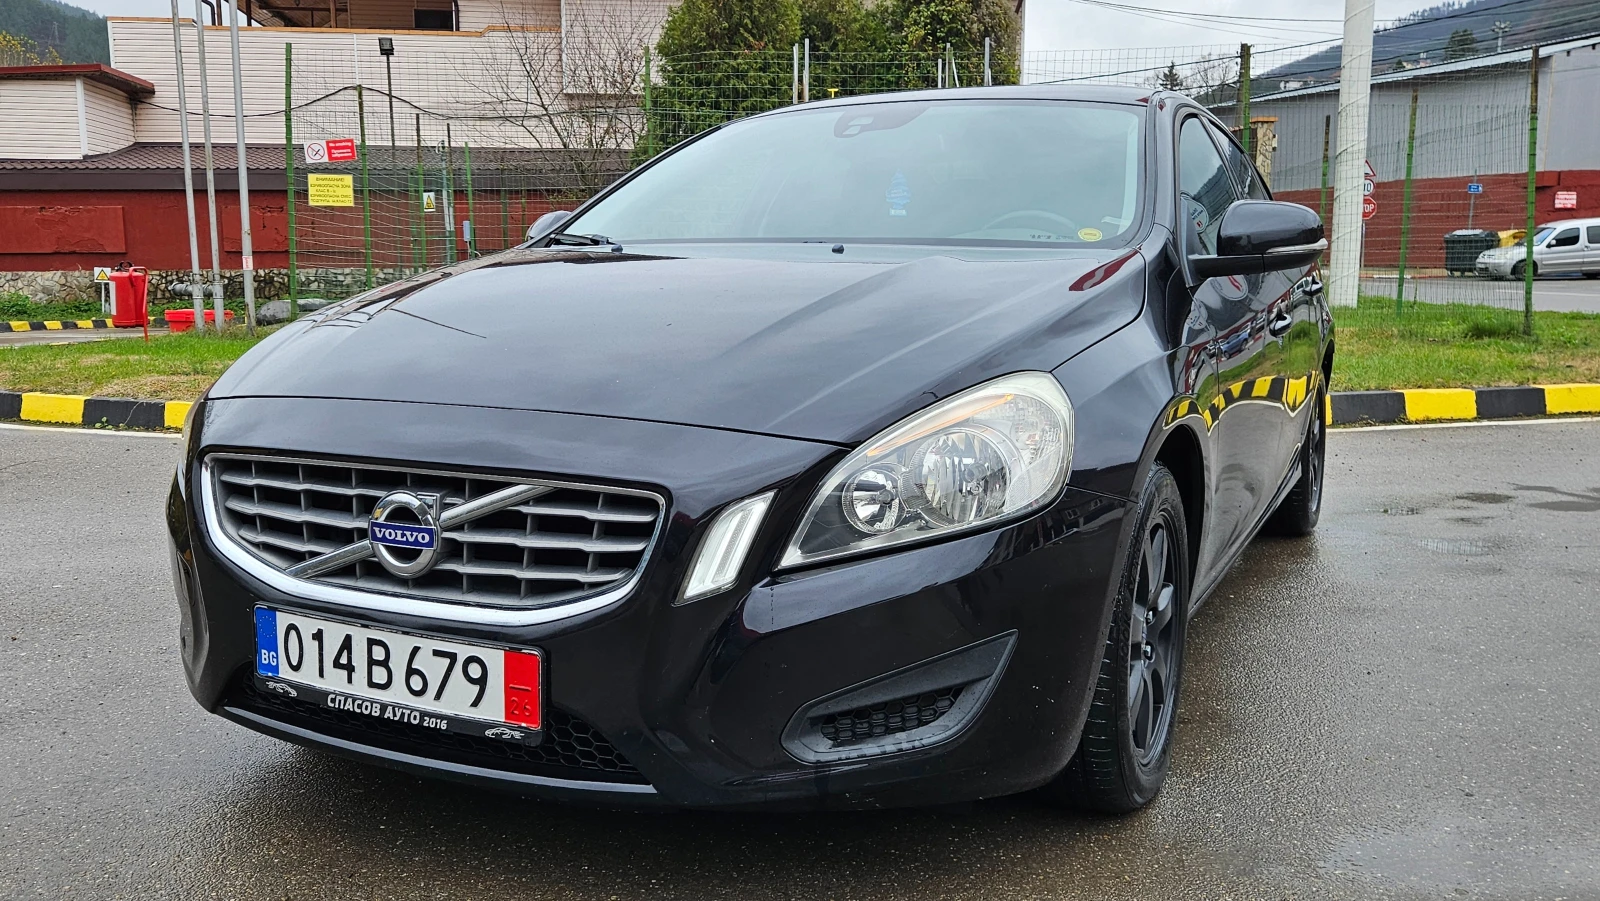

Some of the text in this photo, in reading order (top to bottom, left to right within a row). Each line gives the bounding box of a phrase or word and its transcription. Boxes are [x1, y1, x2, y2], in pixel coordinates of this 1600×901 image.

[373, 526, 430, 543] VOLVO
[261, 649, 277, 666] BG
[327, 694, 448, 730] СПАСОВ АУТО 2016
[511, 697, 532, 716] 26
